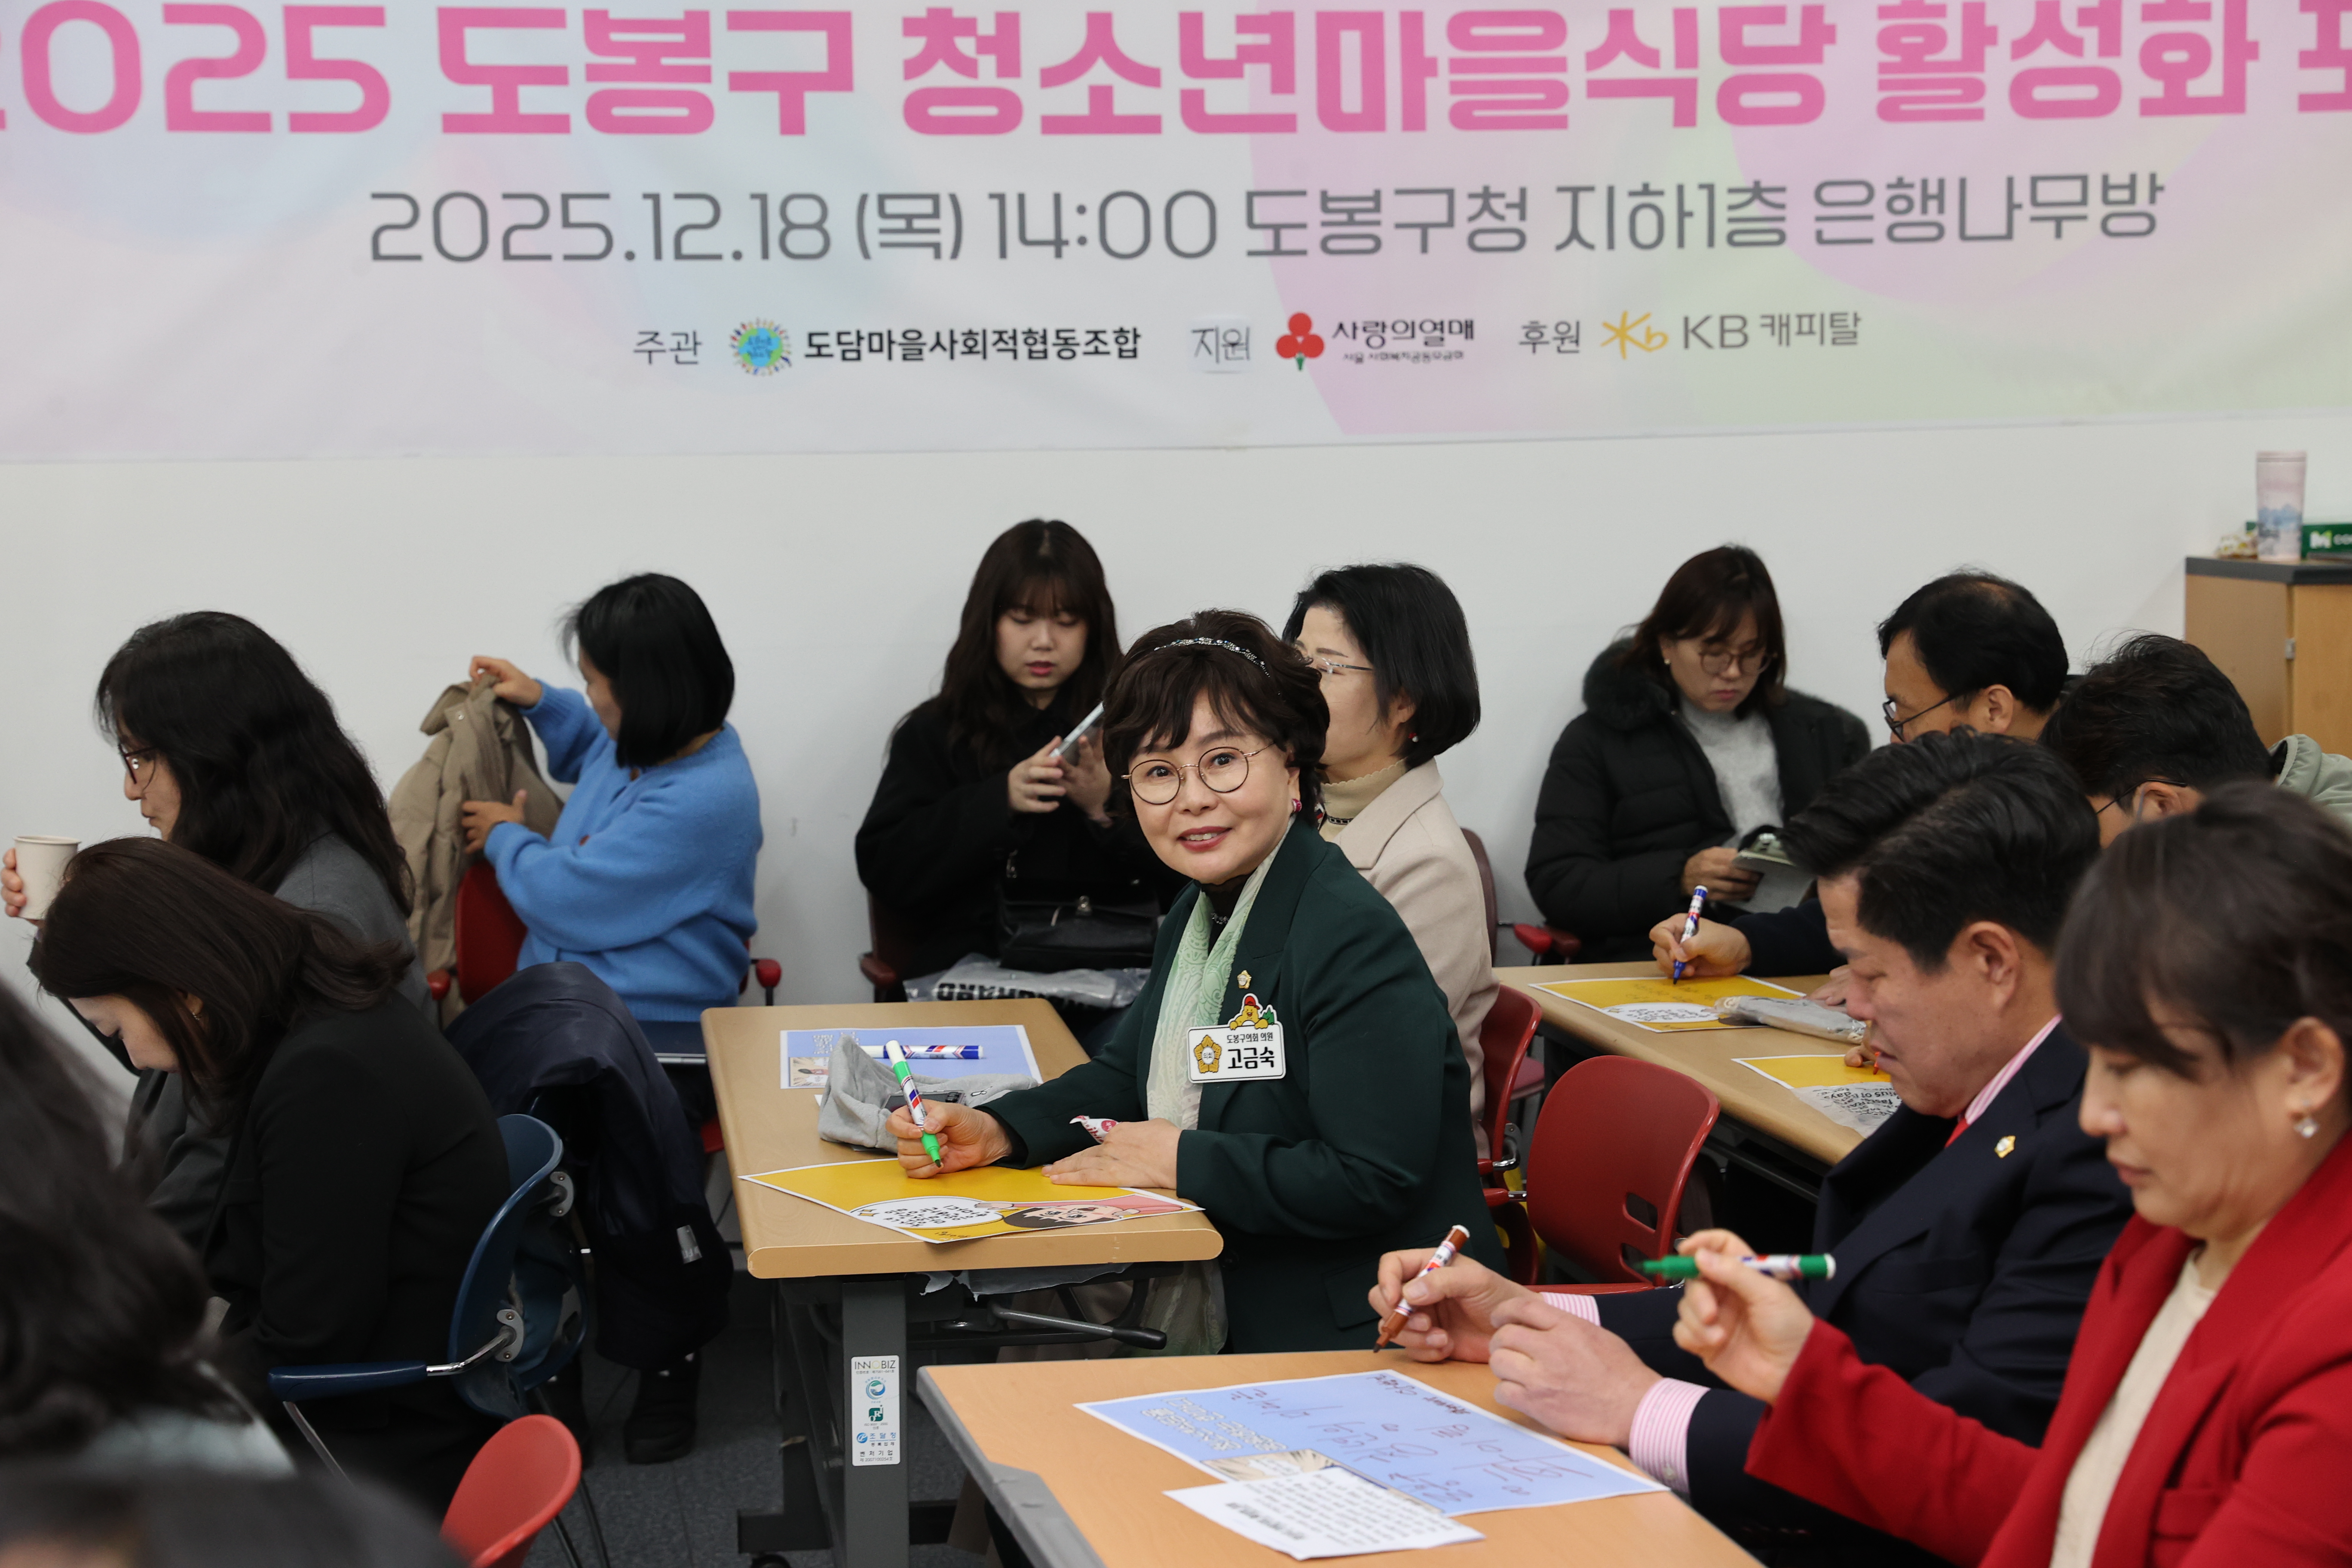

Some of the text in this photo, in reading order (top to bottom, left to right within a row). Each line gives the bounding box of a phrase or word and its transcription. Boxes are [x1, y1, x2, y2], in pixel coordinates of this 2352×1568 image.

[0, 0, 391, 134] 025
[438, 8, 854, 135] 도봉구
[903, 5, 1837, 135] 청소년마을식당
[1877, 0, 2260, 123] 활성화
[372, 174, 2164, 263] 2025.12.18 (목) 14:00 도봉구청 지하1층 은행나무방
[635, 331, 701, 364] 주관
[805, 328, 1141, 362] 도담마을사회적협동조합
[1193, 320, 1474, 363] 지원 사랑의열매
[1521, 322, 1580, 354] 후원
[1685, 316, 1748, 349] KB
[1762, 313, 1860, 346] 캐피탈
[1227, 1032, 1274, 1044] 도봉구의회 의원
[1228, 1046, 1274, 1069] 고금숙
[854, 1360, 896, 1369] INNOBIZ
